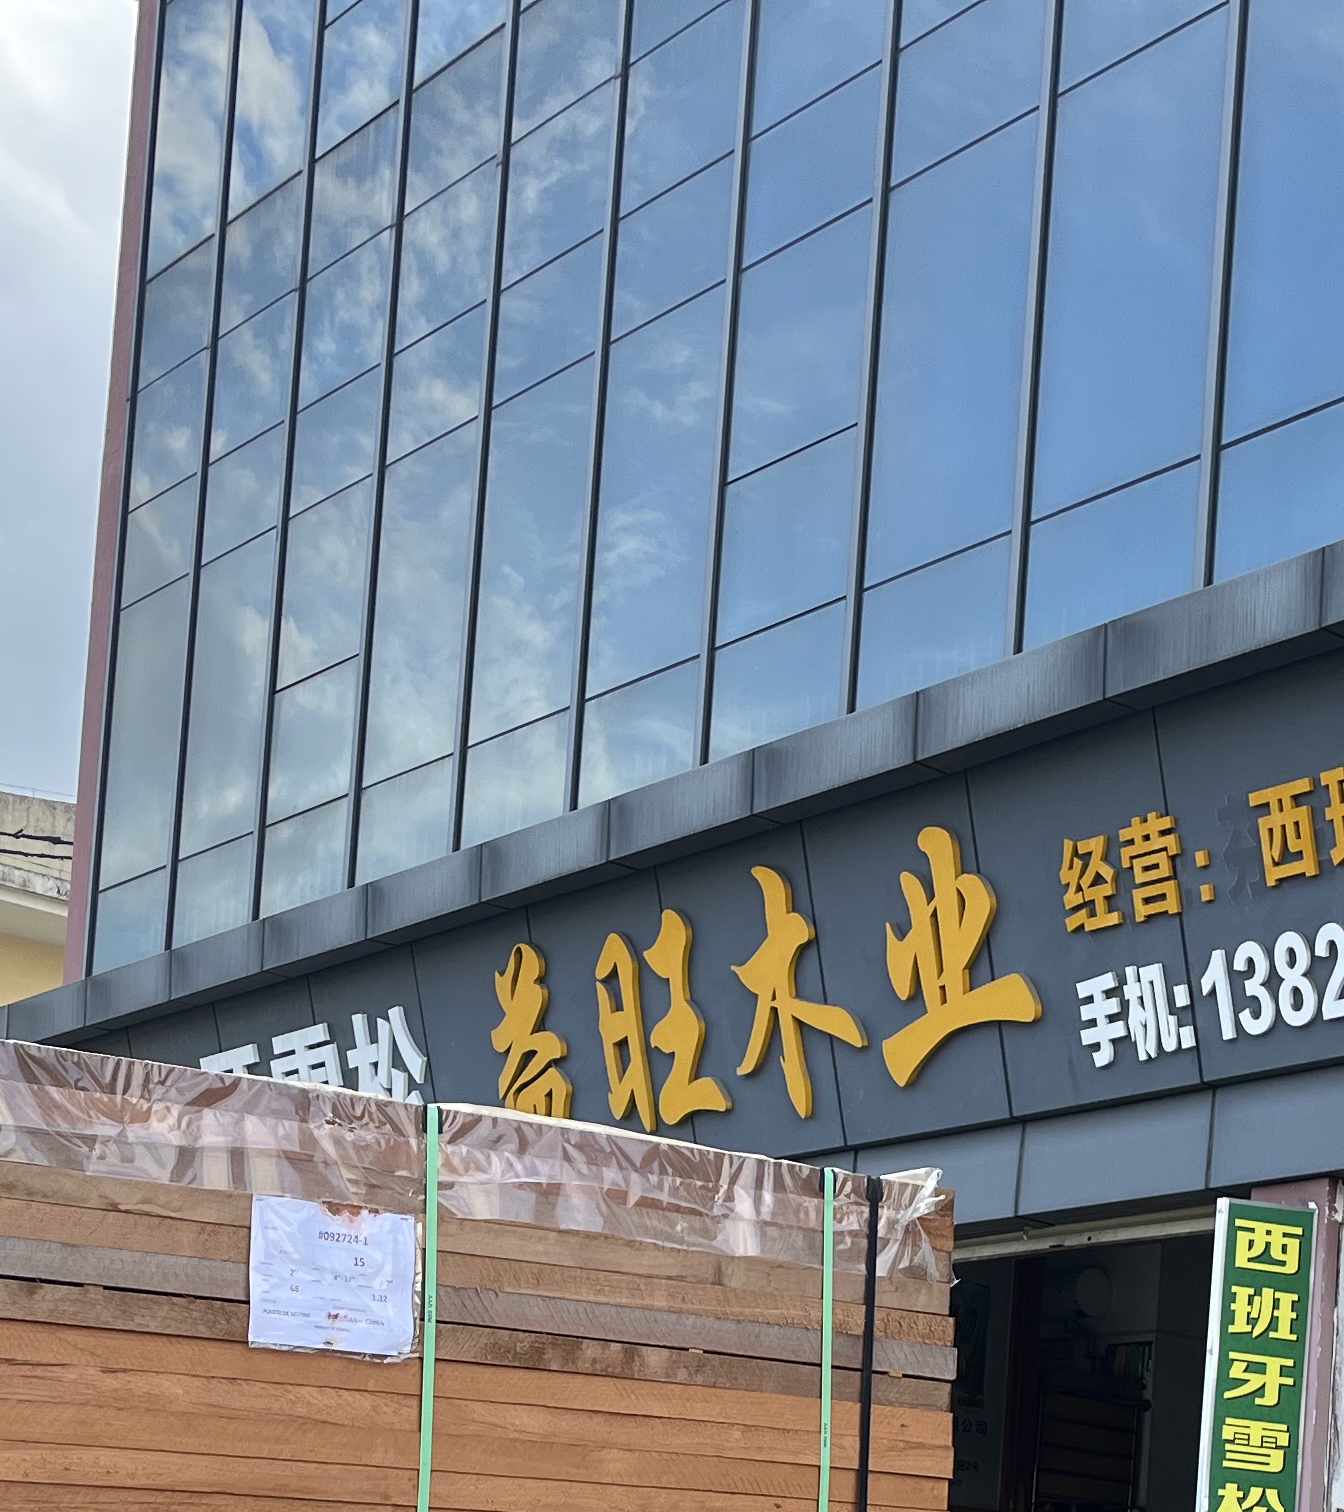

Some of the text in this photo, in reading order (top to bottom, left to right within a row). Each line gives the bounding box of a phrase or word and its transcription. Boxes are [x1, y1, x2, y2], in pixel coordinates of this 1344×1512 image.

[491, 826, 1043, 1132] 益旺木业
[318, 1231, 369, 1246] #092724-1
